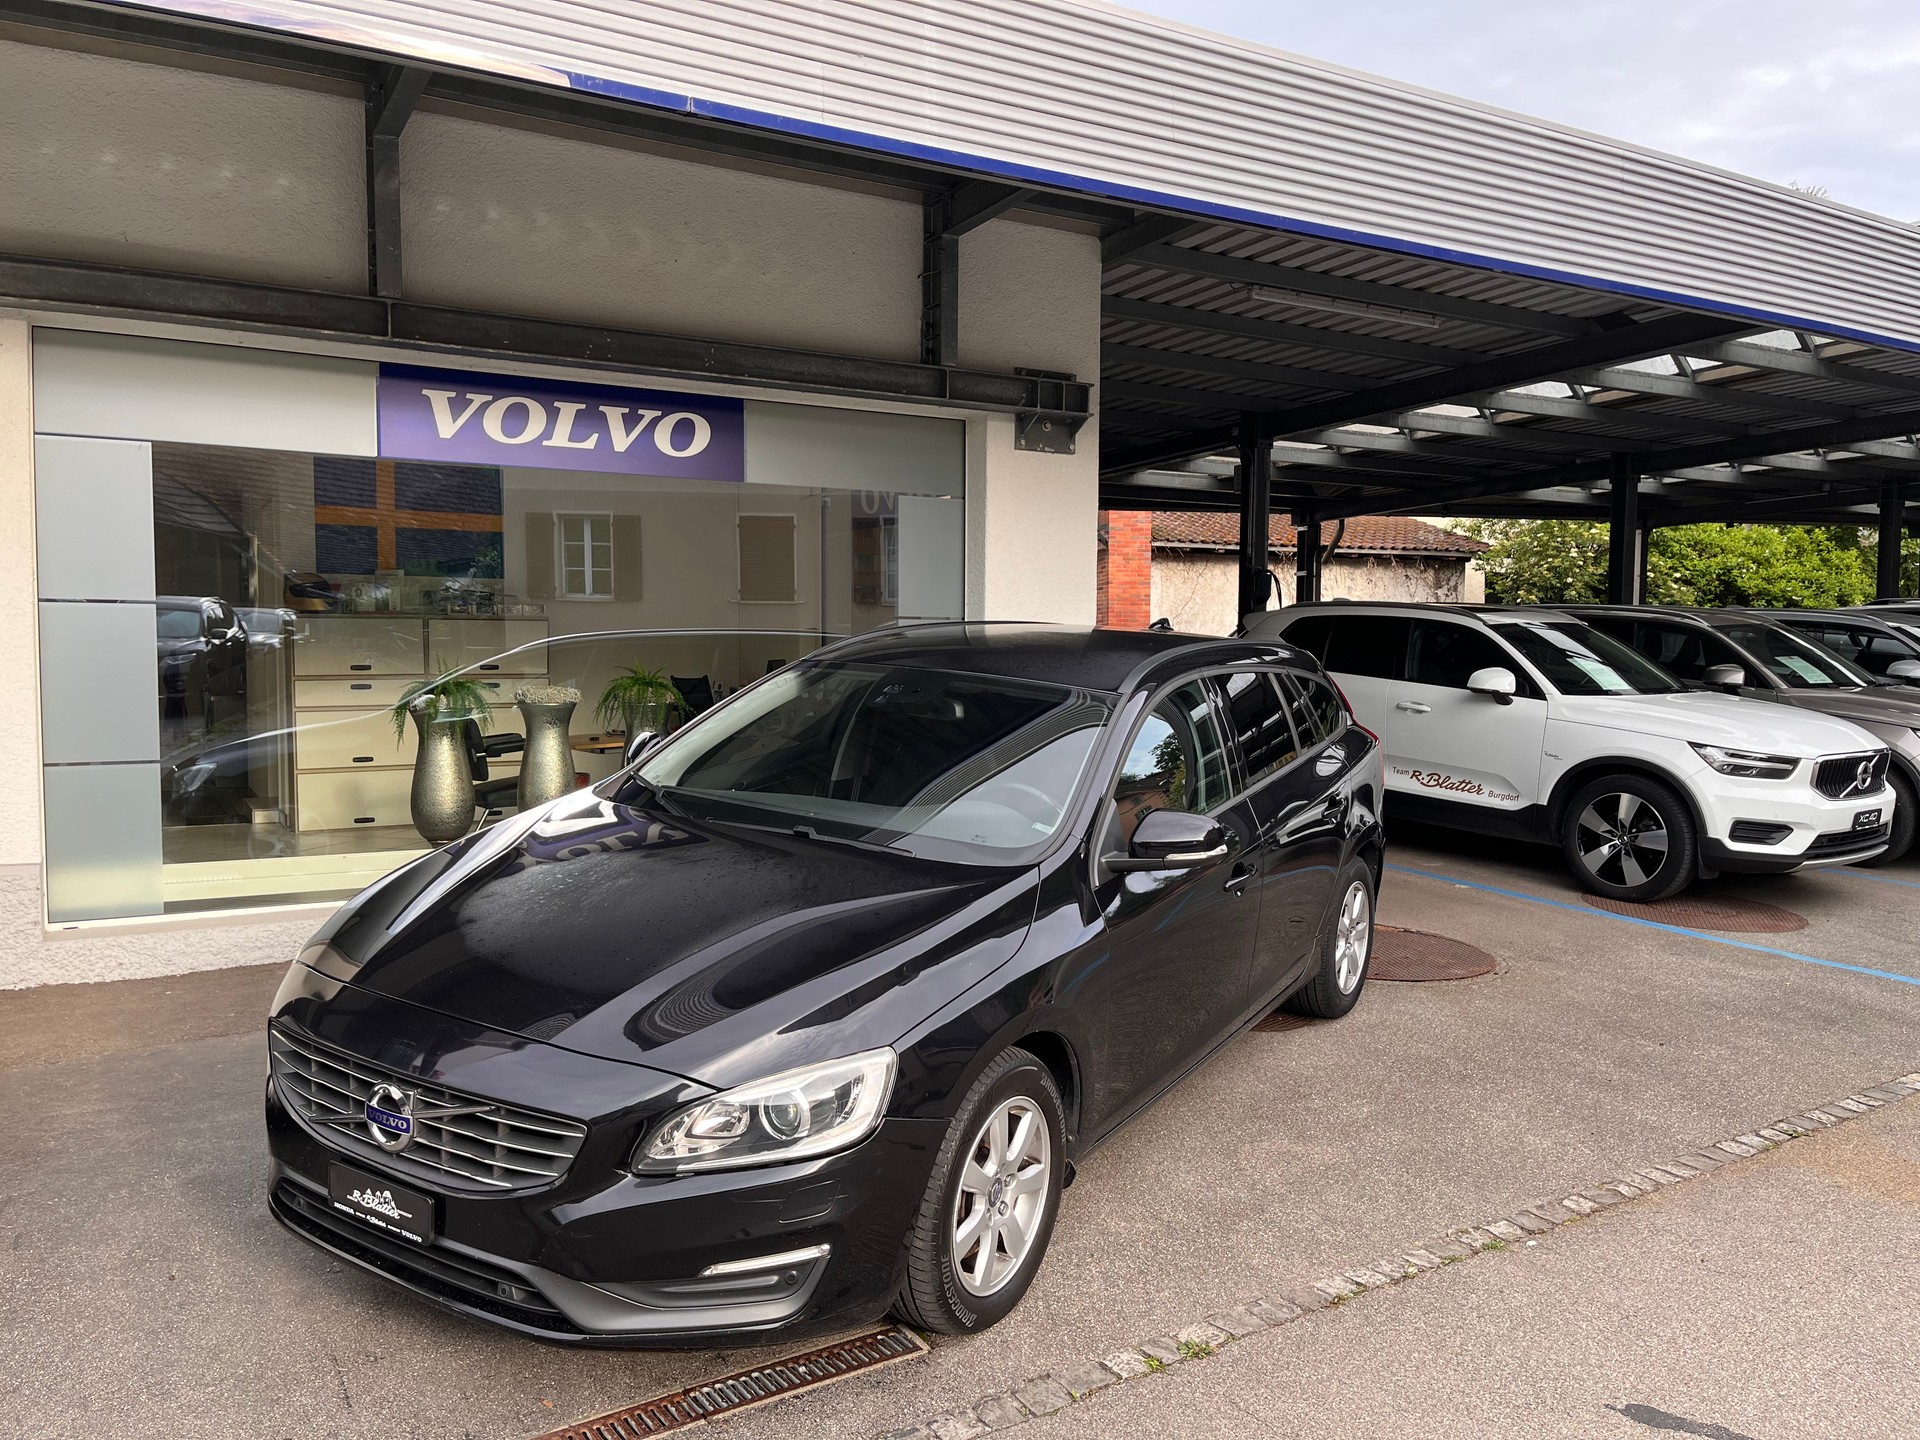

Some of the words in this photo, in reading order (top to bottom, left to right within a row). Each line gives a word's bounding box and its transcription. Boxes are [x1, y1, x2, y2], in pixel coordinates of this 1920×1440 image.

[421, 388, 712, 458] VOLVO
[1392, 766, 1410, 776] Team
[1409, 769, 1485, 796] R.Blatter
[1487, 790, 1520, 802] Burgdorf
[368, 1108, 407, 1130] VOLVO
[1040, 1072, 1067, 1146] BRIDGESTONE
[401, 1230, 422, 1243] VOLVO
[940, 1253, 978, 1329] BRIDGESTONE
